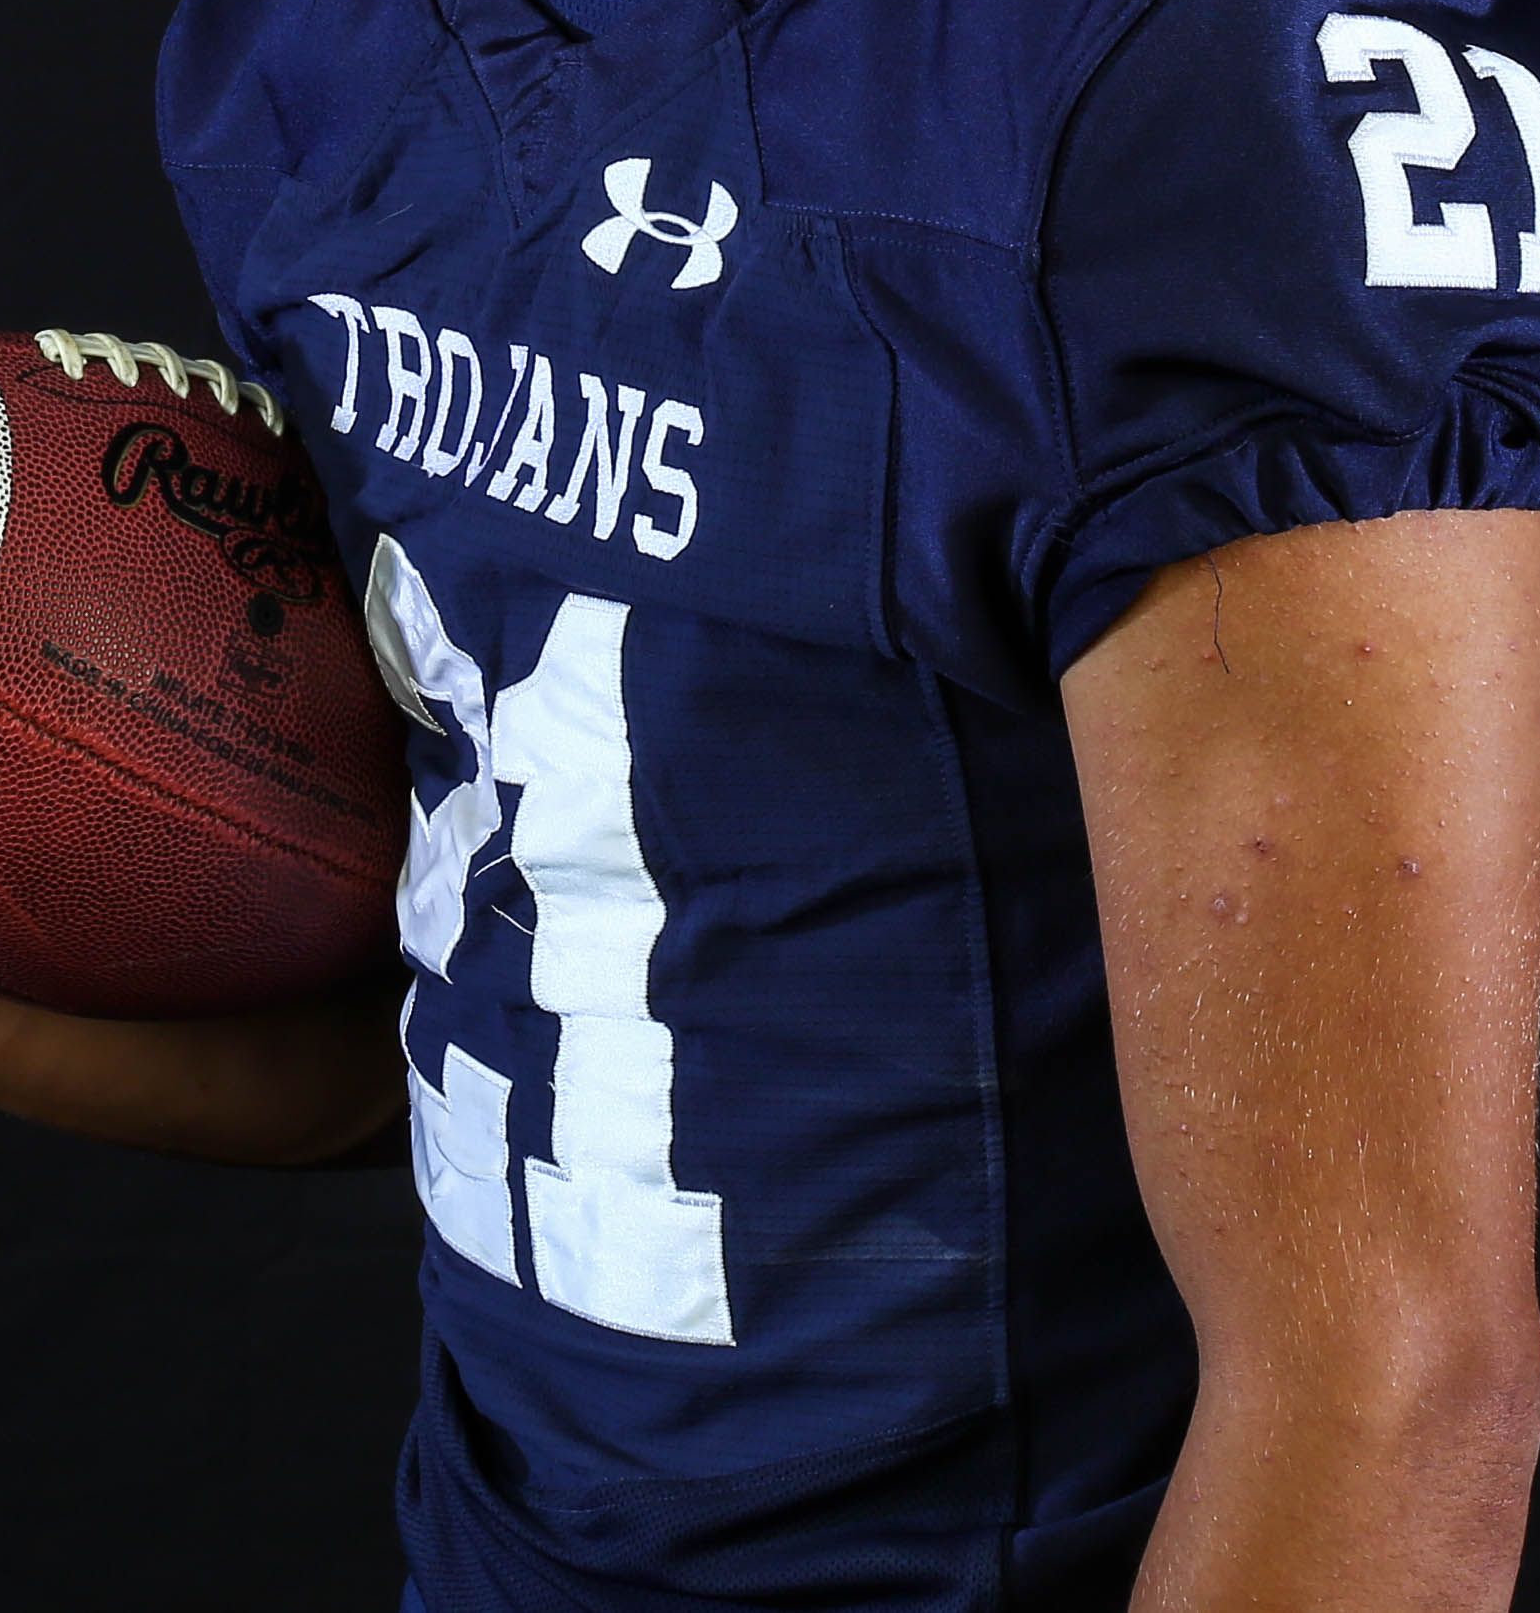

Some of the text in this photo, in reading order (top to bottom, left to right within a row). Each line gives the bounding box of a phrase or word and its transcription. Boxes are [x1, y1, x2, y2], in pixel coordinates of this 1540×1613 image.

[308, 293, 704, 560] TROJANS
[150, 671, 229, 725] INFLATE
[365, 534, 736, 1346] 21
